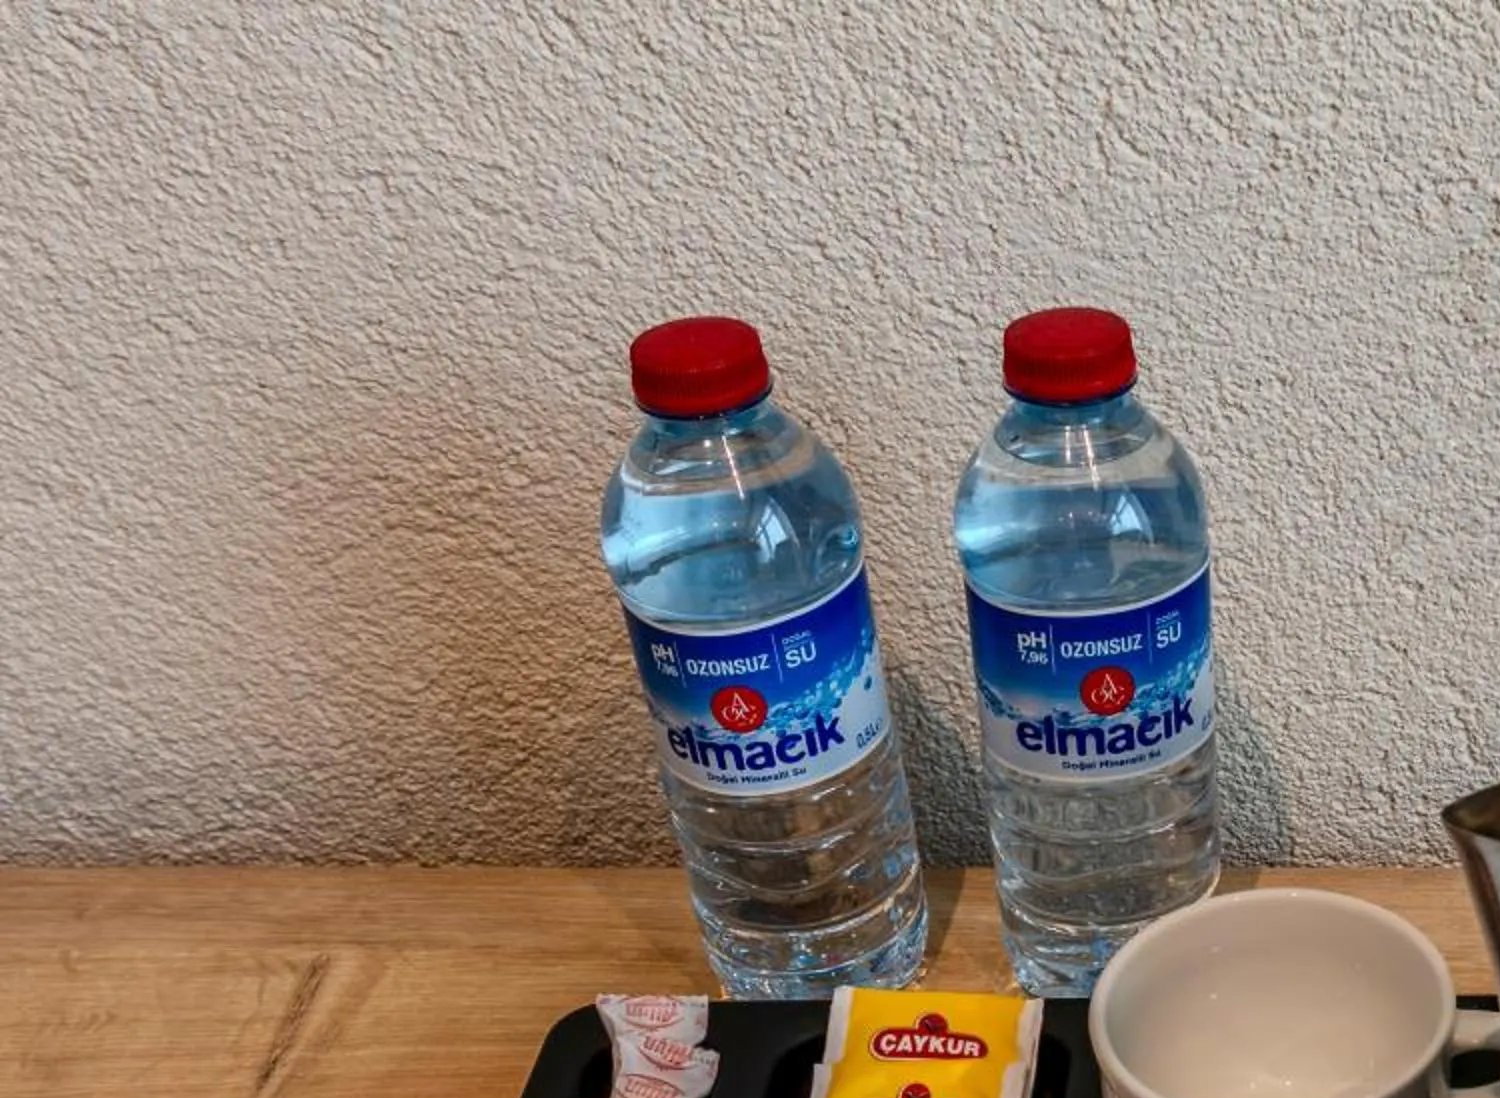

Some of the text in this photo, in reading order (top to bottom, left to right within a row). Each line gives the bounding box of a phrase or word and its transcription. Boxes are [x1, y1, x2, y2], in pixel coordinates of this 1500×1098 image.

[1017, 631, 1047, 649] pH
[1060, 633, 1143, 659] OZONSUZ
[1156, 621, 1182, 649] SU
[686, 653, 771, 677] OZONSUZ
[785, 640, 817, 668] SU
[879, 1033, 981, 1057] ÇAYKUR
